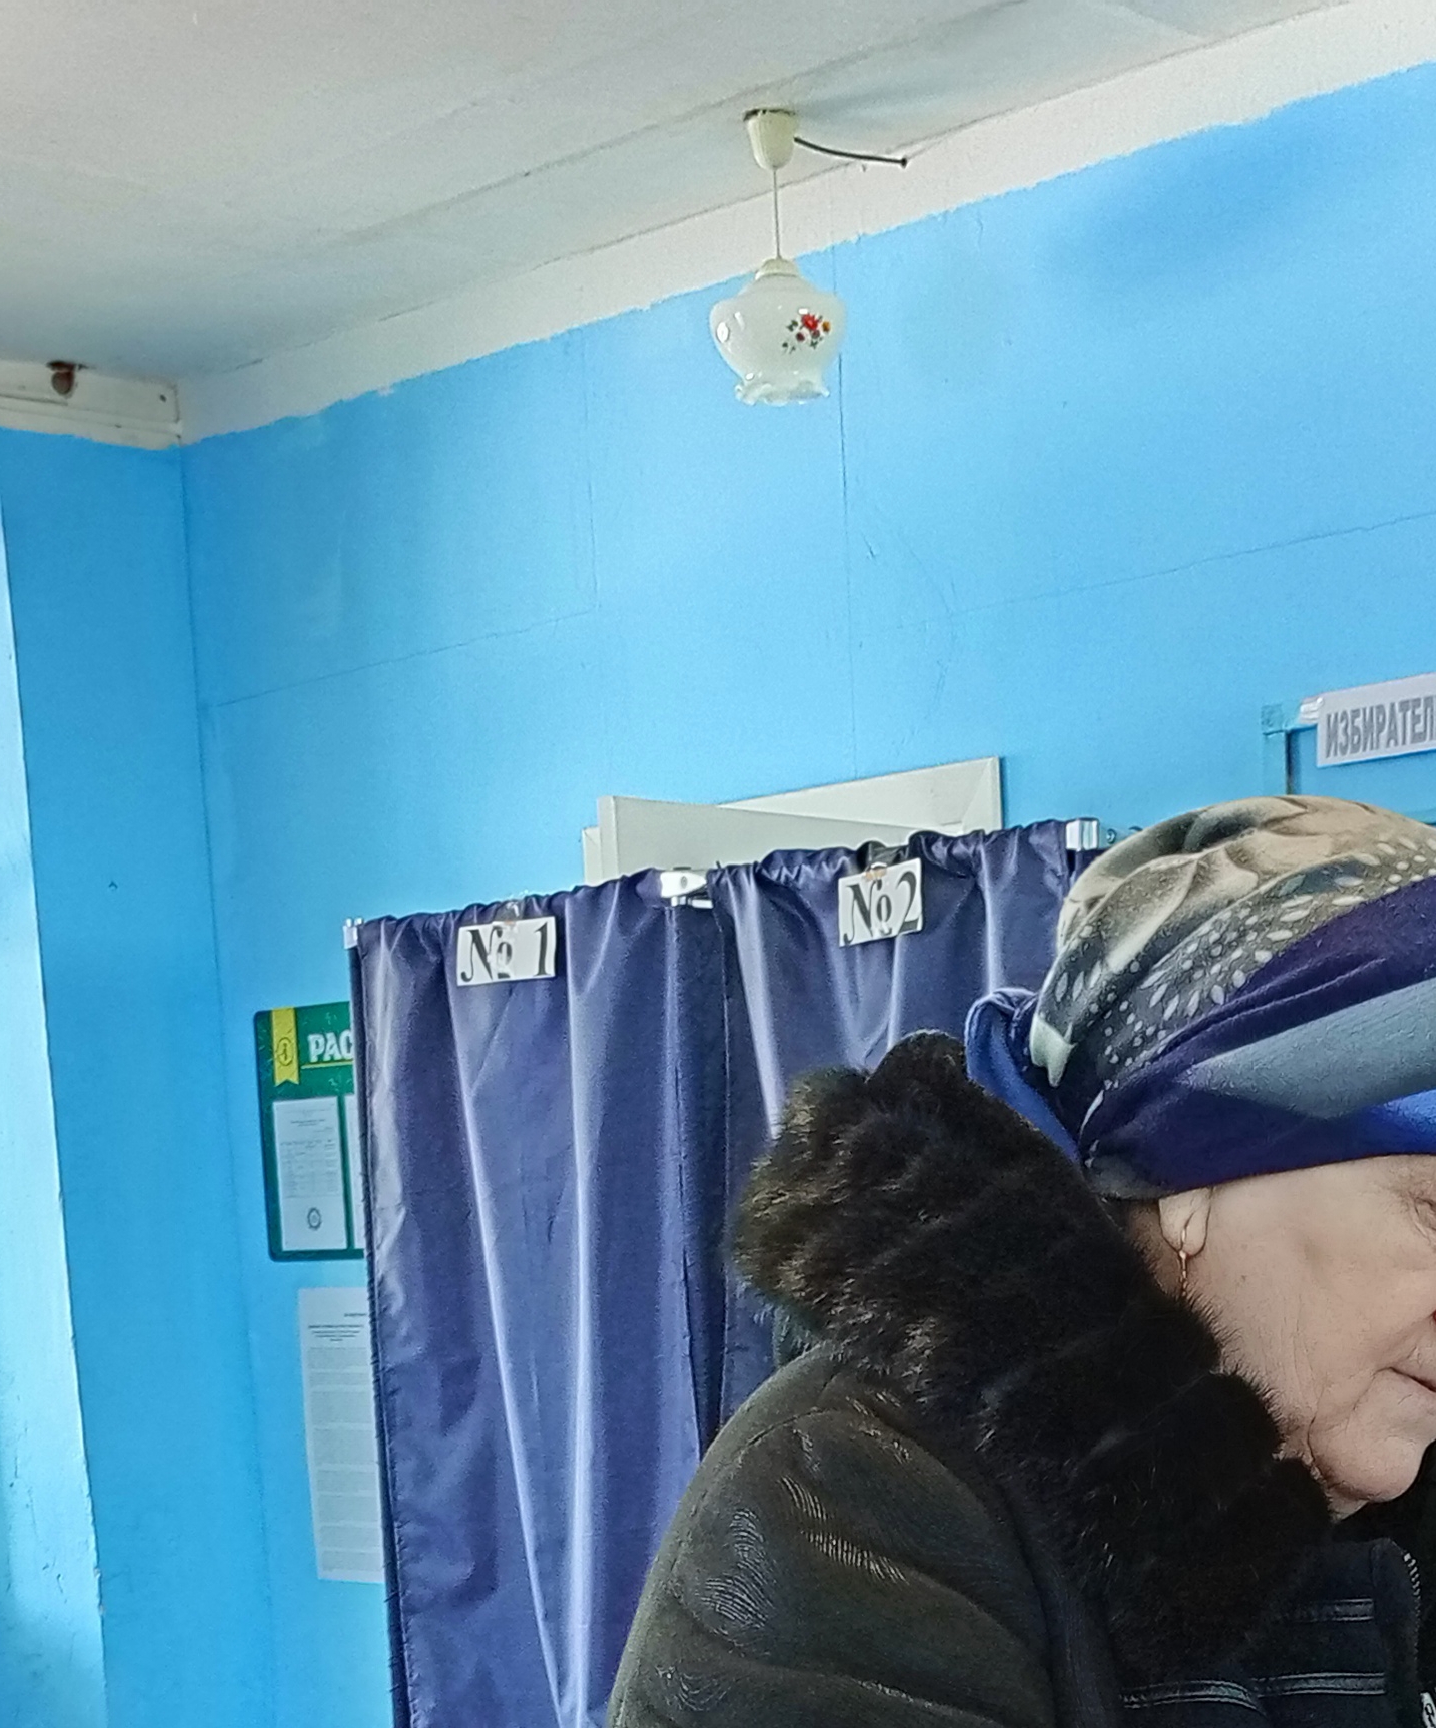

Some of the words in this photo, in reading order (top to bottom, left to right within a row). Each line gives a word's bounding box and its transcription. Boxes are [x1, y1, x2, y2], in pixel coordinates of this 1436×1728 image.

[843, 881, 892, 944] №
[896, 870, 922, 932] 2
[460, 924, 512, 983] №
[534, 921, 551, 977] 1
